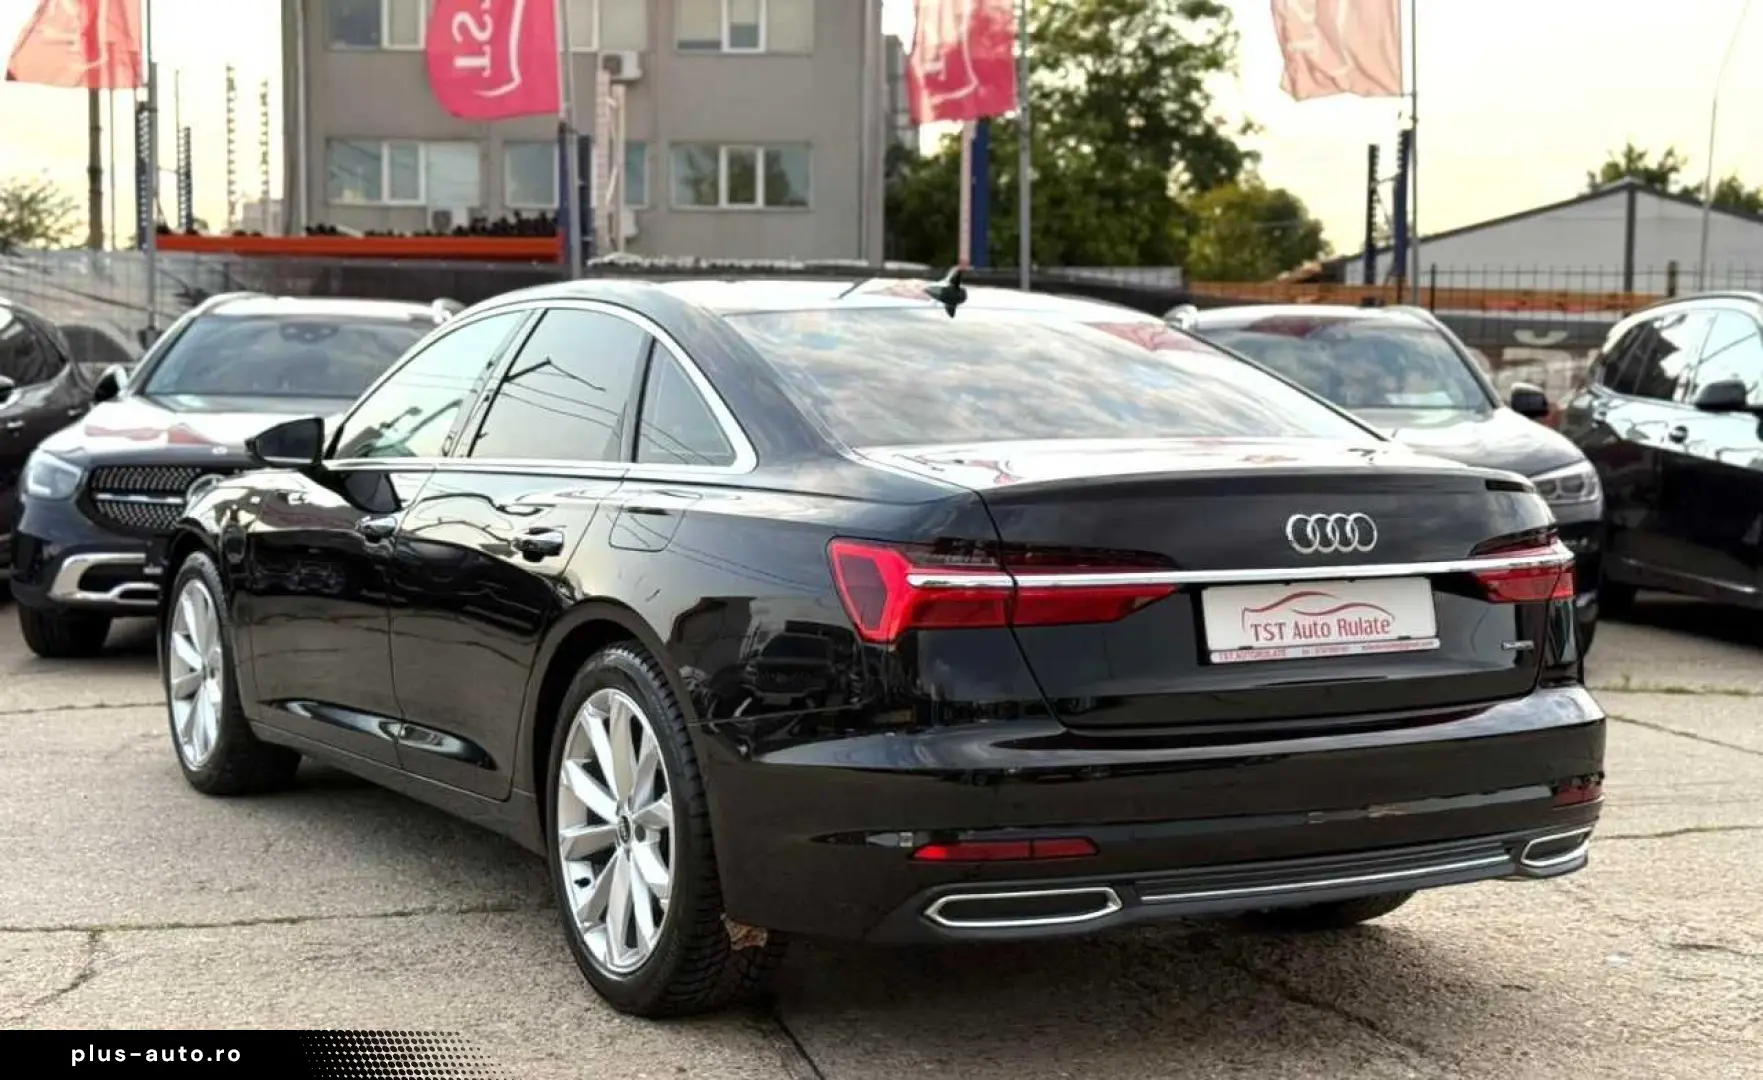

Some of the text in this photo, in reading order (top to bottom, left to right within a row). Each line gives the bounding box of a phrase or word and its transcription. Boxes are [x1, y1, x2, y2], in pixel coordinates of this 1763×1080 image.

[1250, 617, 1391, 642] TST Auto Rulate
